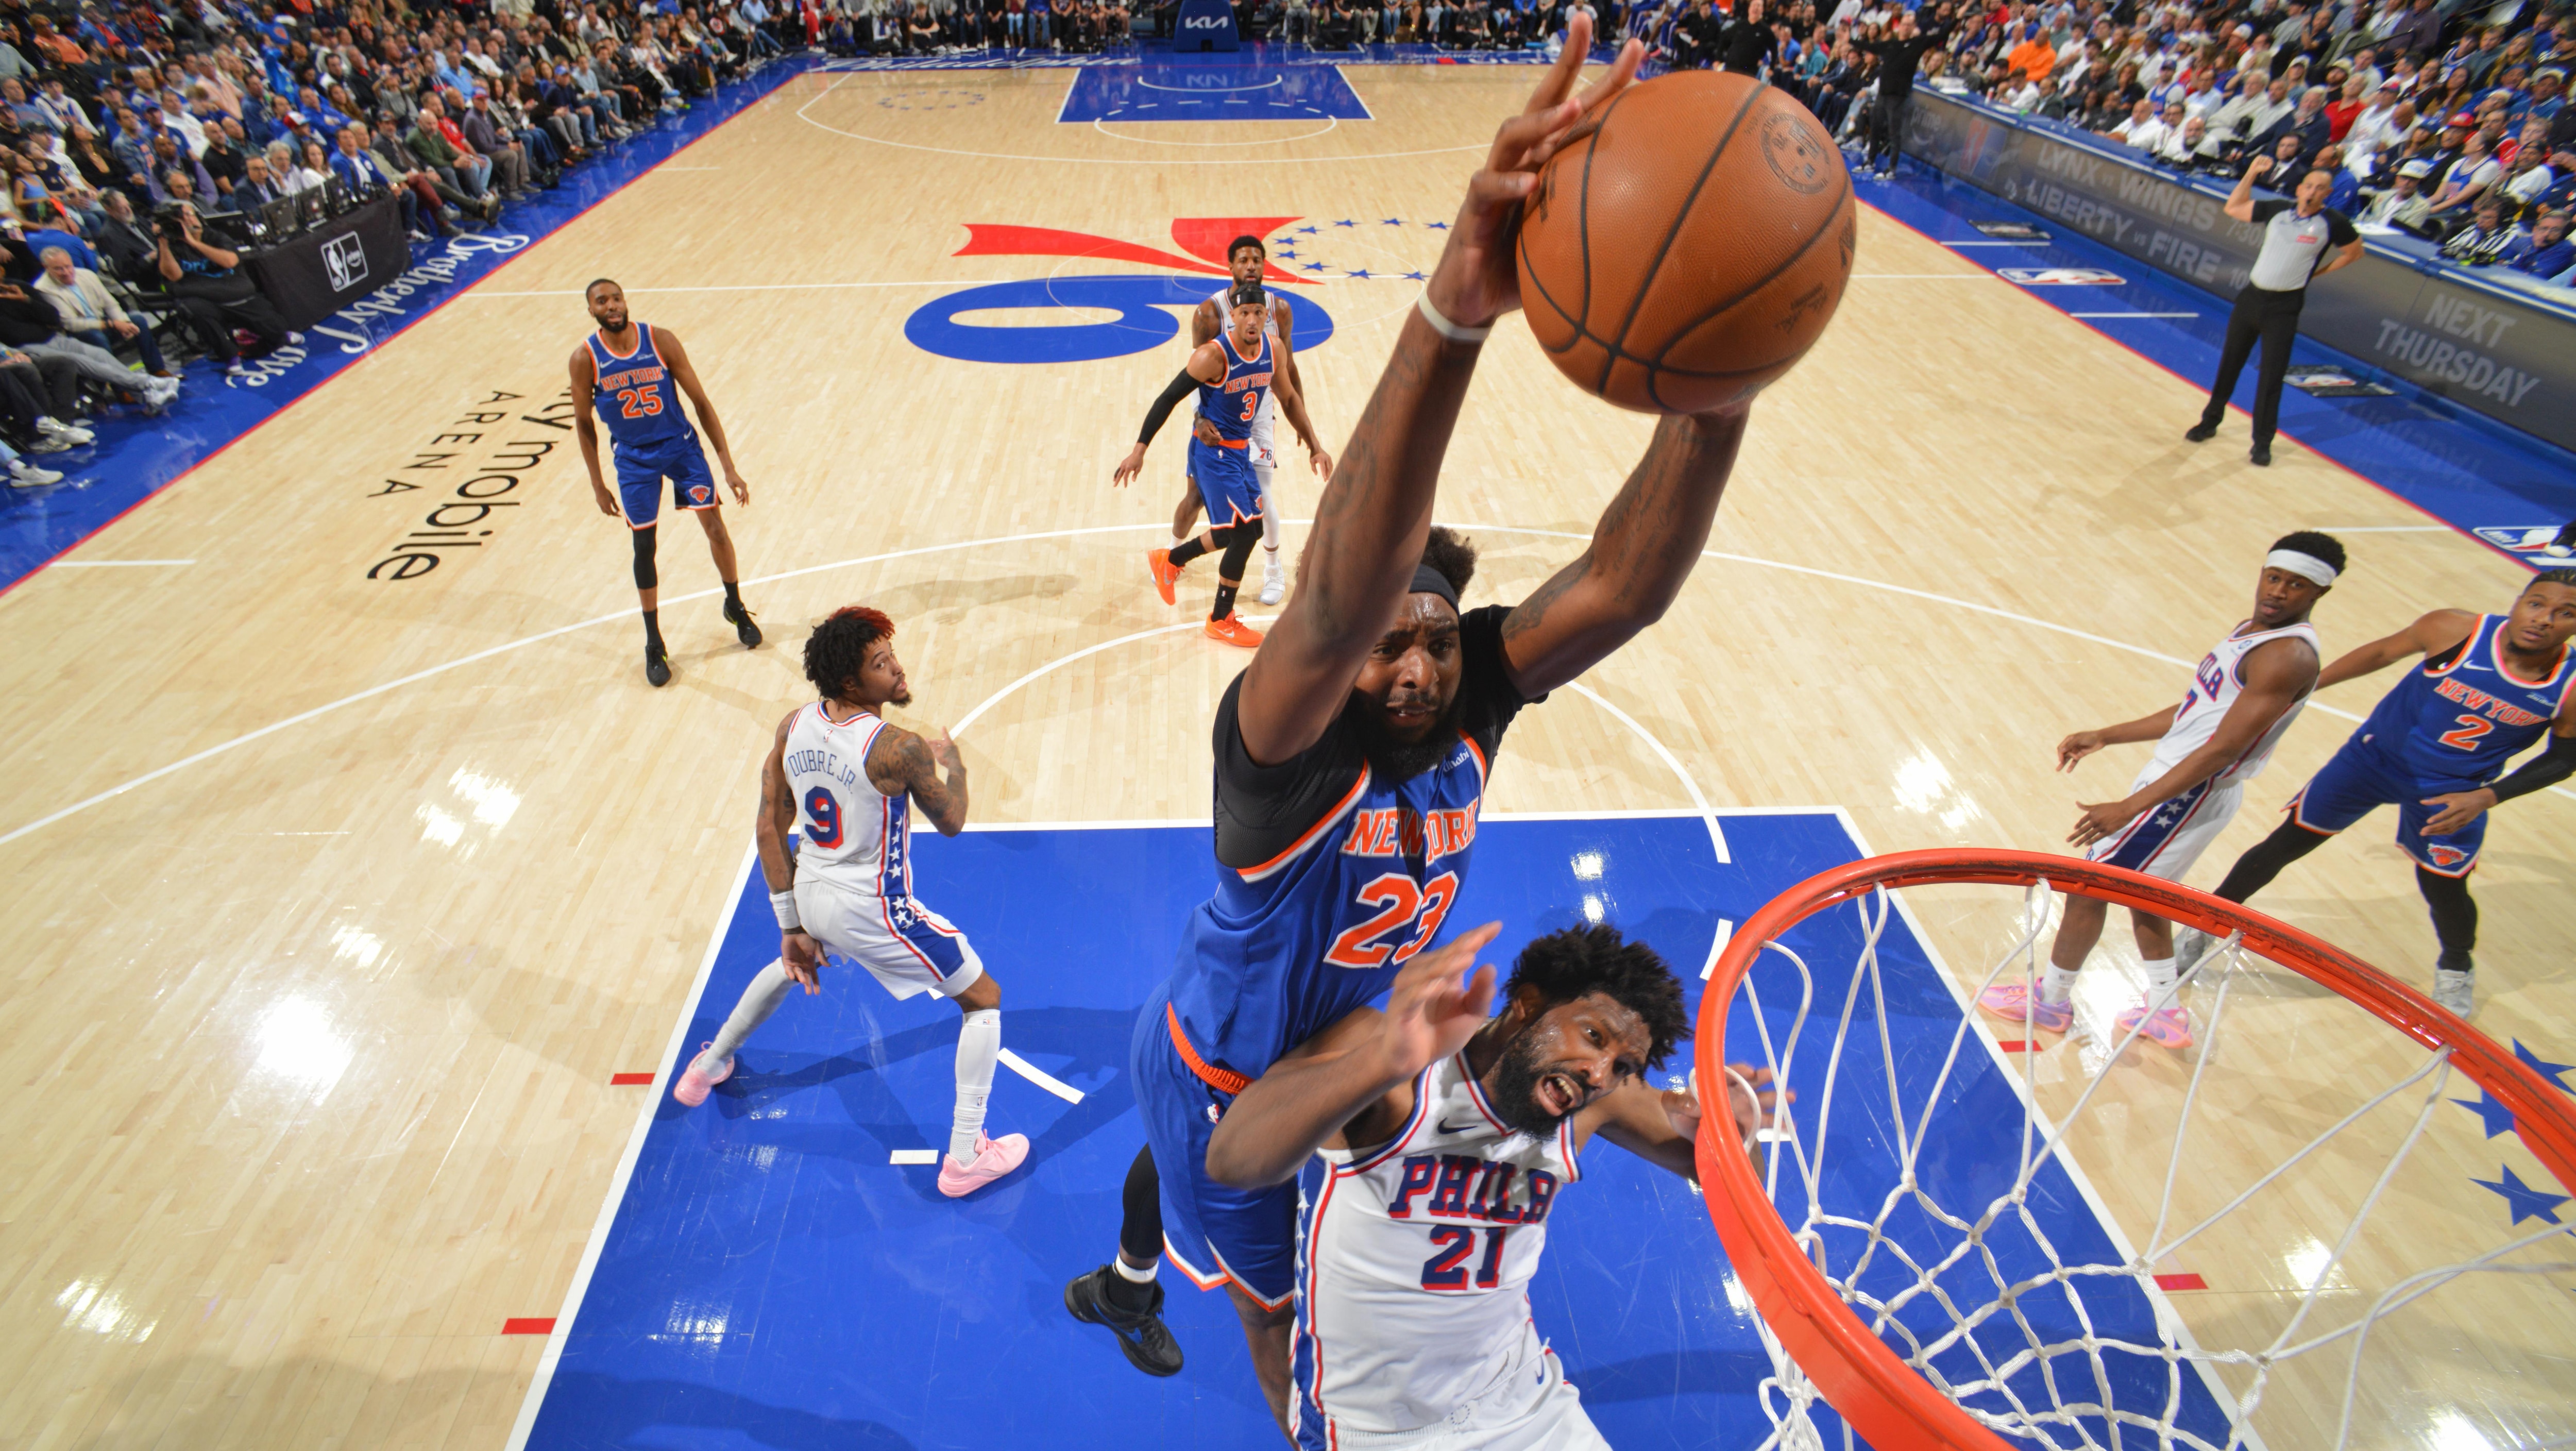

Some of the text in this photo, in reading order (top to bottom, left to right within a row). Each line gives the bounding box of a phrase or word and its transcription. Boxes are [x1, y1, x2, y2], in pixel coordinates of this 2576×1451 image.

[1185, 16, 1228, 29] KIA
[2037, 142, 2102, 187] LYNX
[2118, 171, 2216, 230] WINGS
[2026, 180, 2134, 242] LIBERTY
[2147, 230, 2222, 283] FIRE
[2424, 293, 2517, 348] NEXT
[600, 366, 665, 392] NEW YORK
[1225, 377, 1251, 394] NEW
[2374, 318, 2541, 407] THURSDAY
[617, 384, 664, 419] 25
[1241, 391, 1258, 421] 3
[366, 390, 527, 498] ARENA
[1260, 448, 1273, 461] 76
[366, 441, 559, 581] mobile
[2434, 677, 2490, 711] NEW
[2437, 714, 2495, 751] 2
[788, 750, 837, 777] OUBRE
[804, 786, 844, 850] 9
[1339, 806, 1426, 858] NEW
[1323, 871, 1459, 968] 23
[1387, 1154, 1558, 1224] PHILA
[1420, 1224, 1506, 1290] 21
